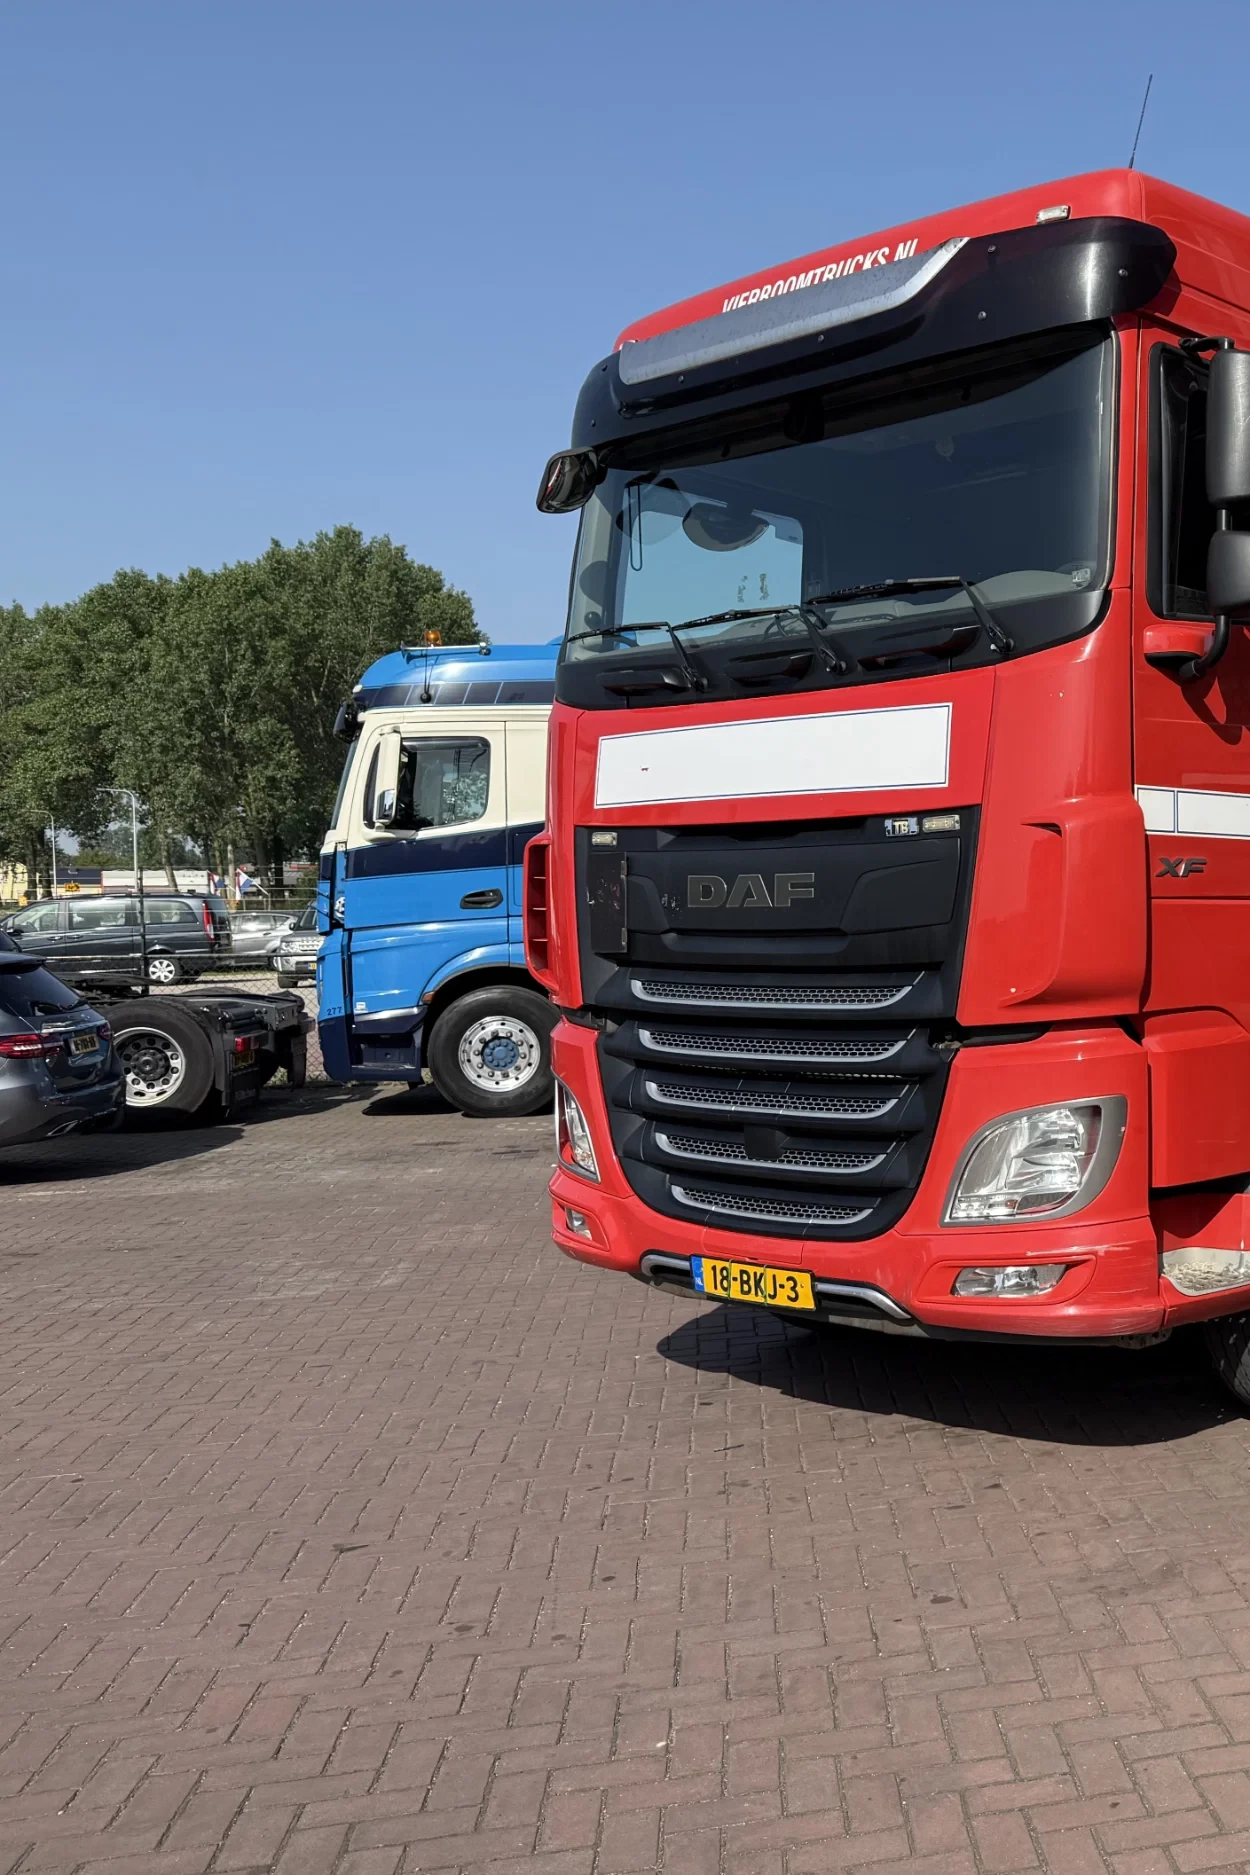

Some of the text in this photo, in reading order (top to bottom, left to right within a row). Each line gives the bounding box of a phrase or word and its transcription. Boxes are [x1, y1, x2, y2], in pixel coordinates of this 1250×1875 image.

[721, 238, 919, 314] VIERBOOMTRUCKSNL
[1155, 857, 1207, 878] XF
[687, 872, 815, 908] DAF
[327, 1007, 342, 1015] 277
[711, 1264, 800, 1302] 18-BKJ-3
